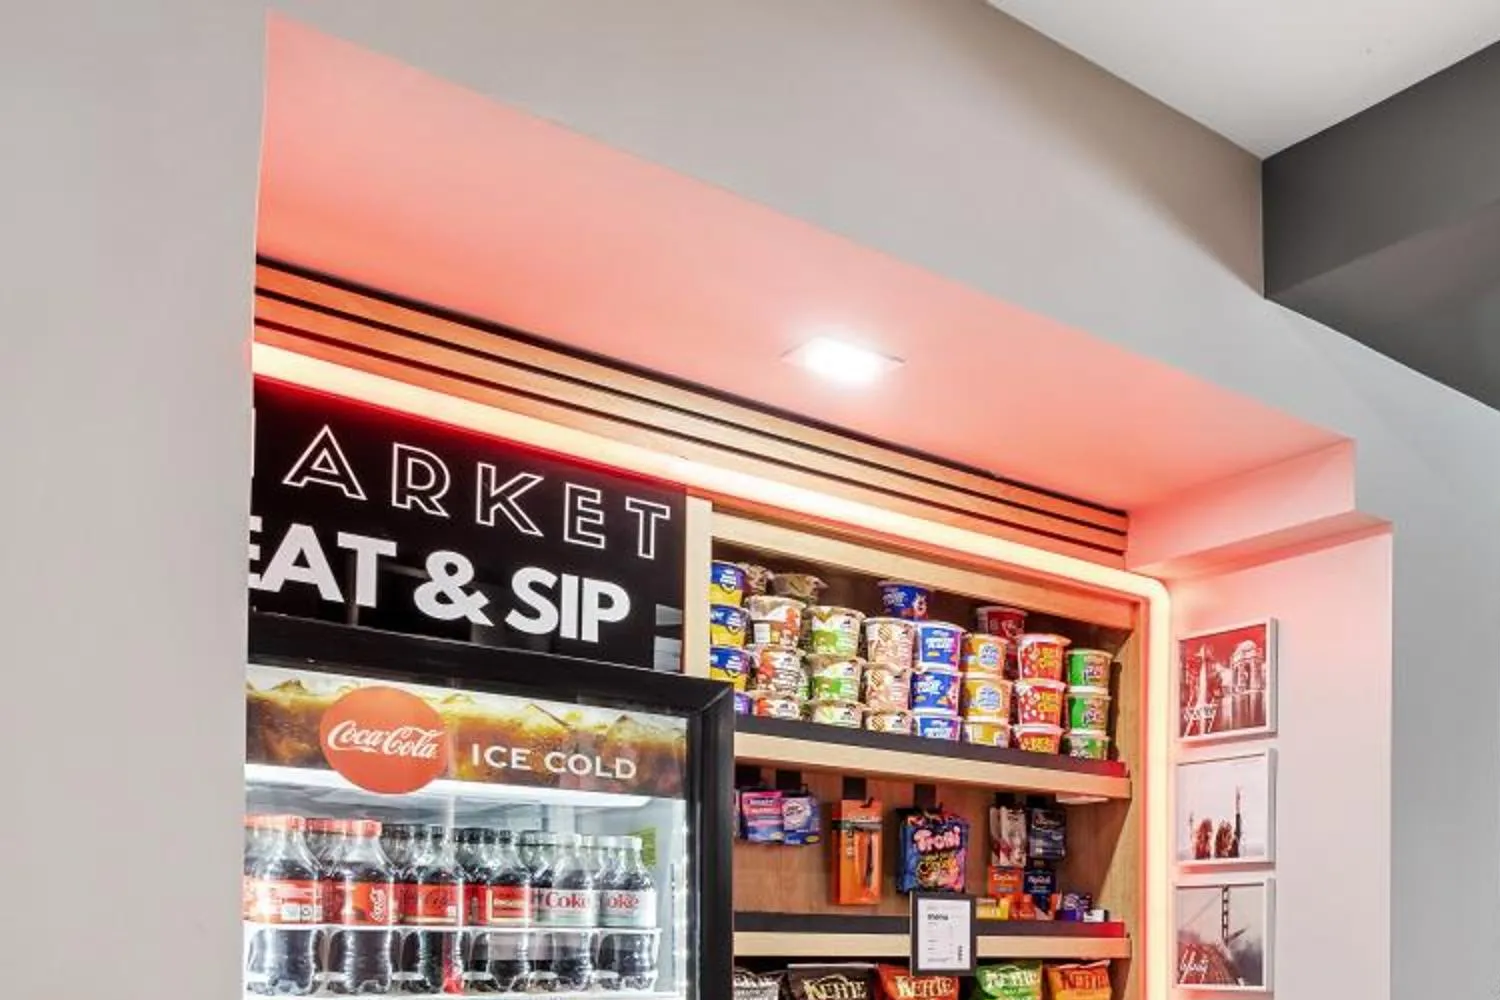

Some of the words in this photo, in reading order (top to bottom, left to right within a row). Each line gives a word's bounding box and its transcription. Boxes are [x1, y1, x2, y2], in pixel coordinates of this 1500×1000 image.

[252, 408, 671, 560] ARKET
[413, 550, 494, 627] &
[505, 566, 631, 643] SIP
[327, 720, 447, 759] Coca-Cola
[471, 743, 532, 772] ICE
[544, 751, 637, 780] COLD
